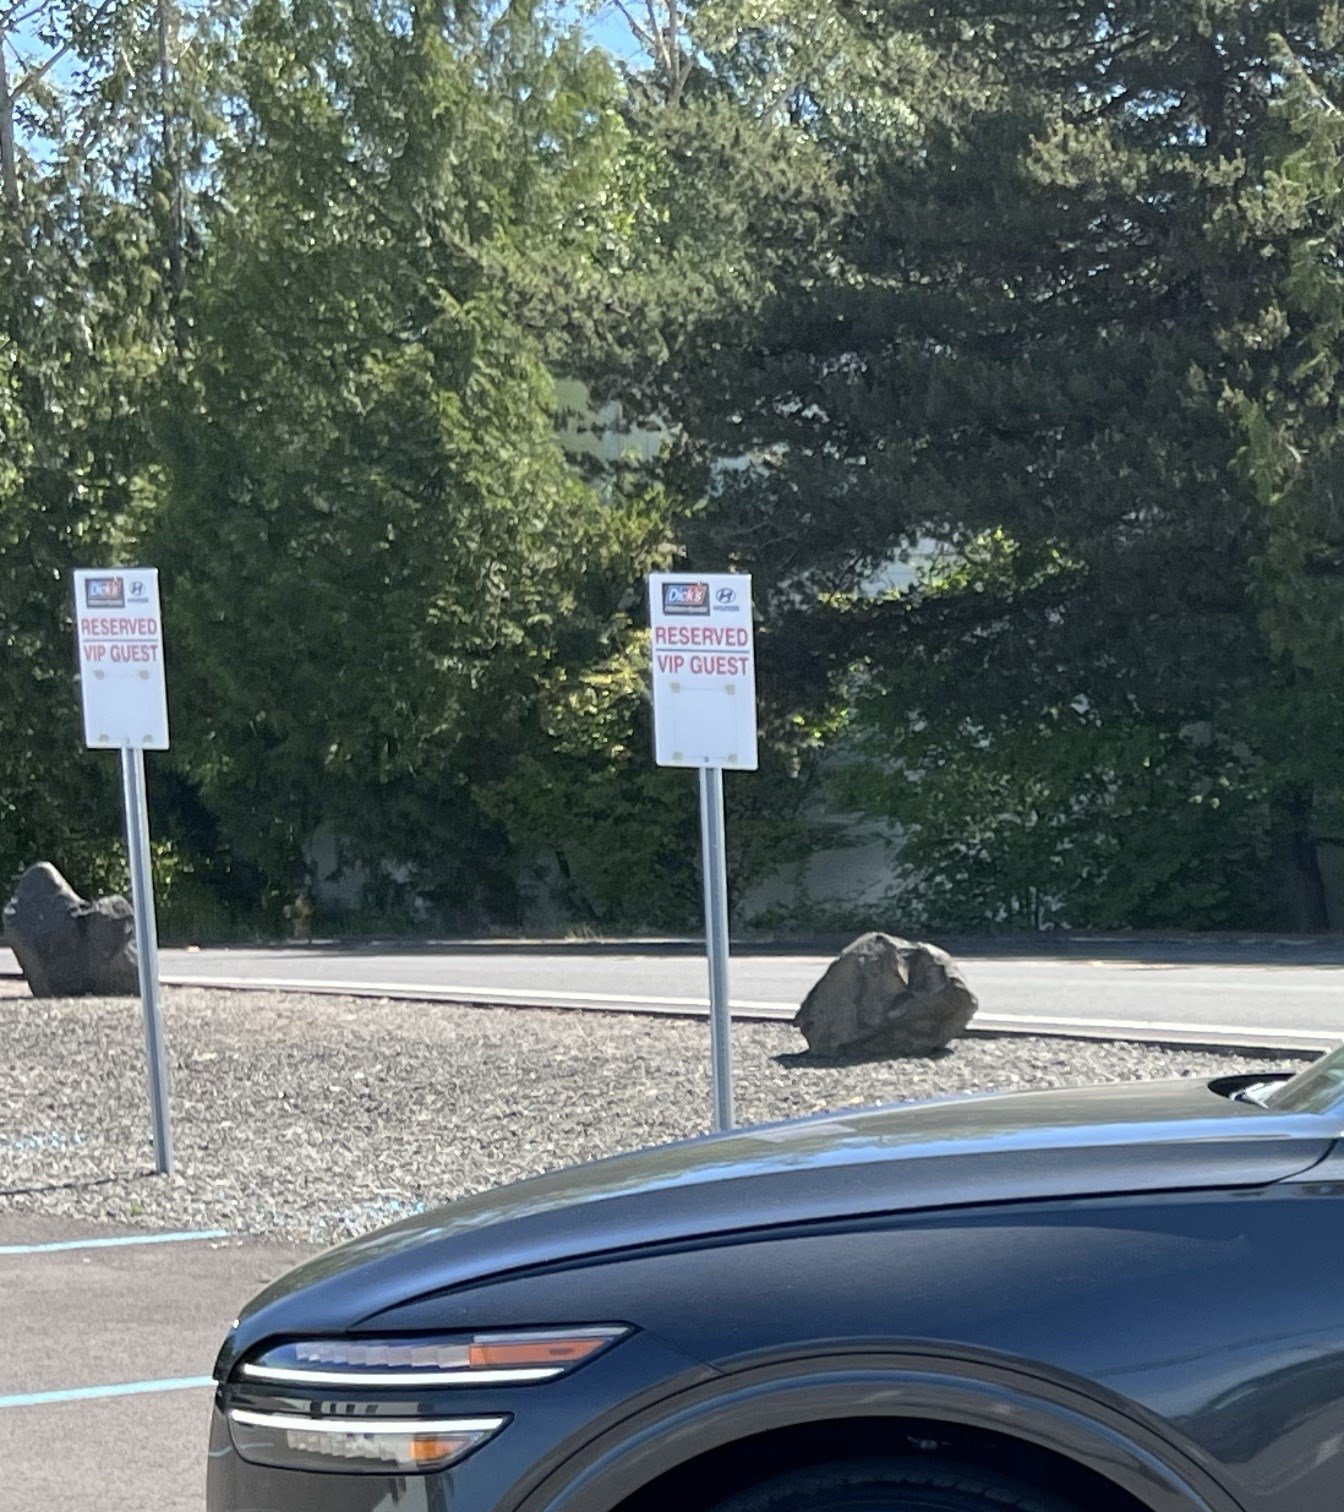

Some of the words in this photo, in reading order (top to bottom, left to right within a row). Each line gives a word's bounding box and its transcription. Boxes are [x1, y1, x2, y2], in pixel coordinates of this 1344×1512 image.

[81, 617, 157, 636] RESERVED
[655, 626, 749, 647] RESERVED
[83, 644, 106, 662] VIP
[110, 643, 158, 662] GUEST
[657, 655, 684, 674] VIP
[690, 656, 749, 676] GUEST
